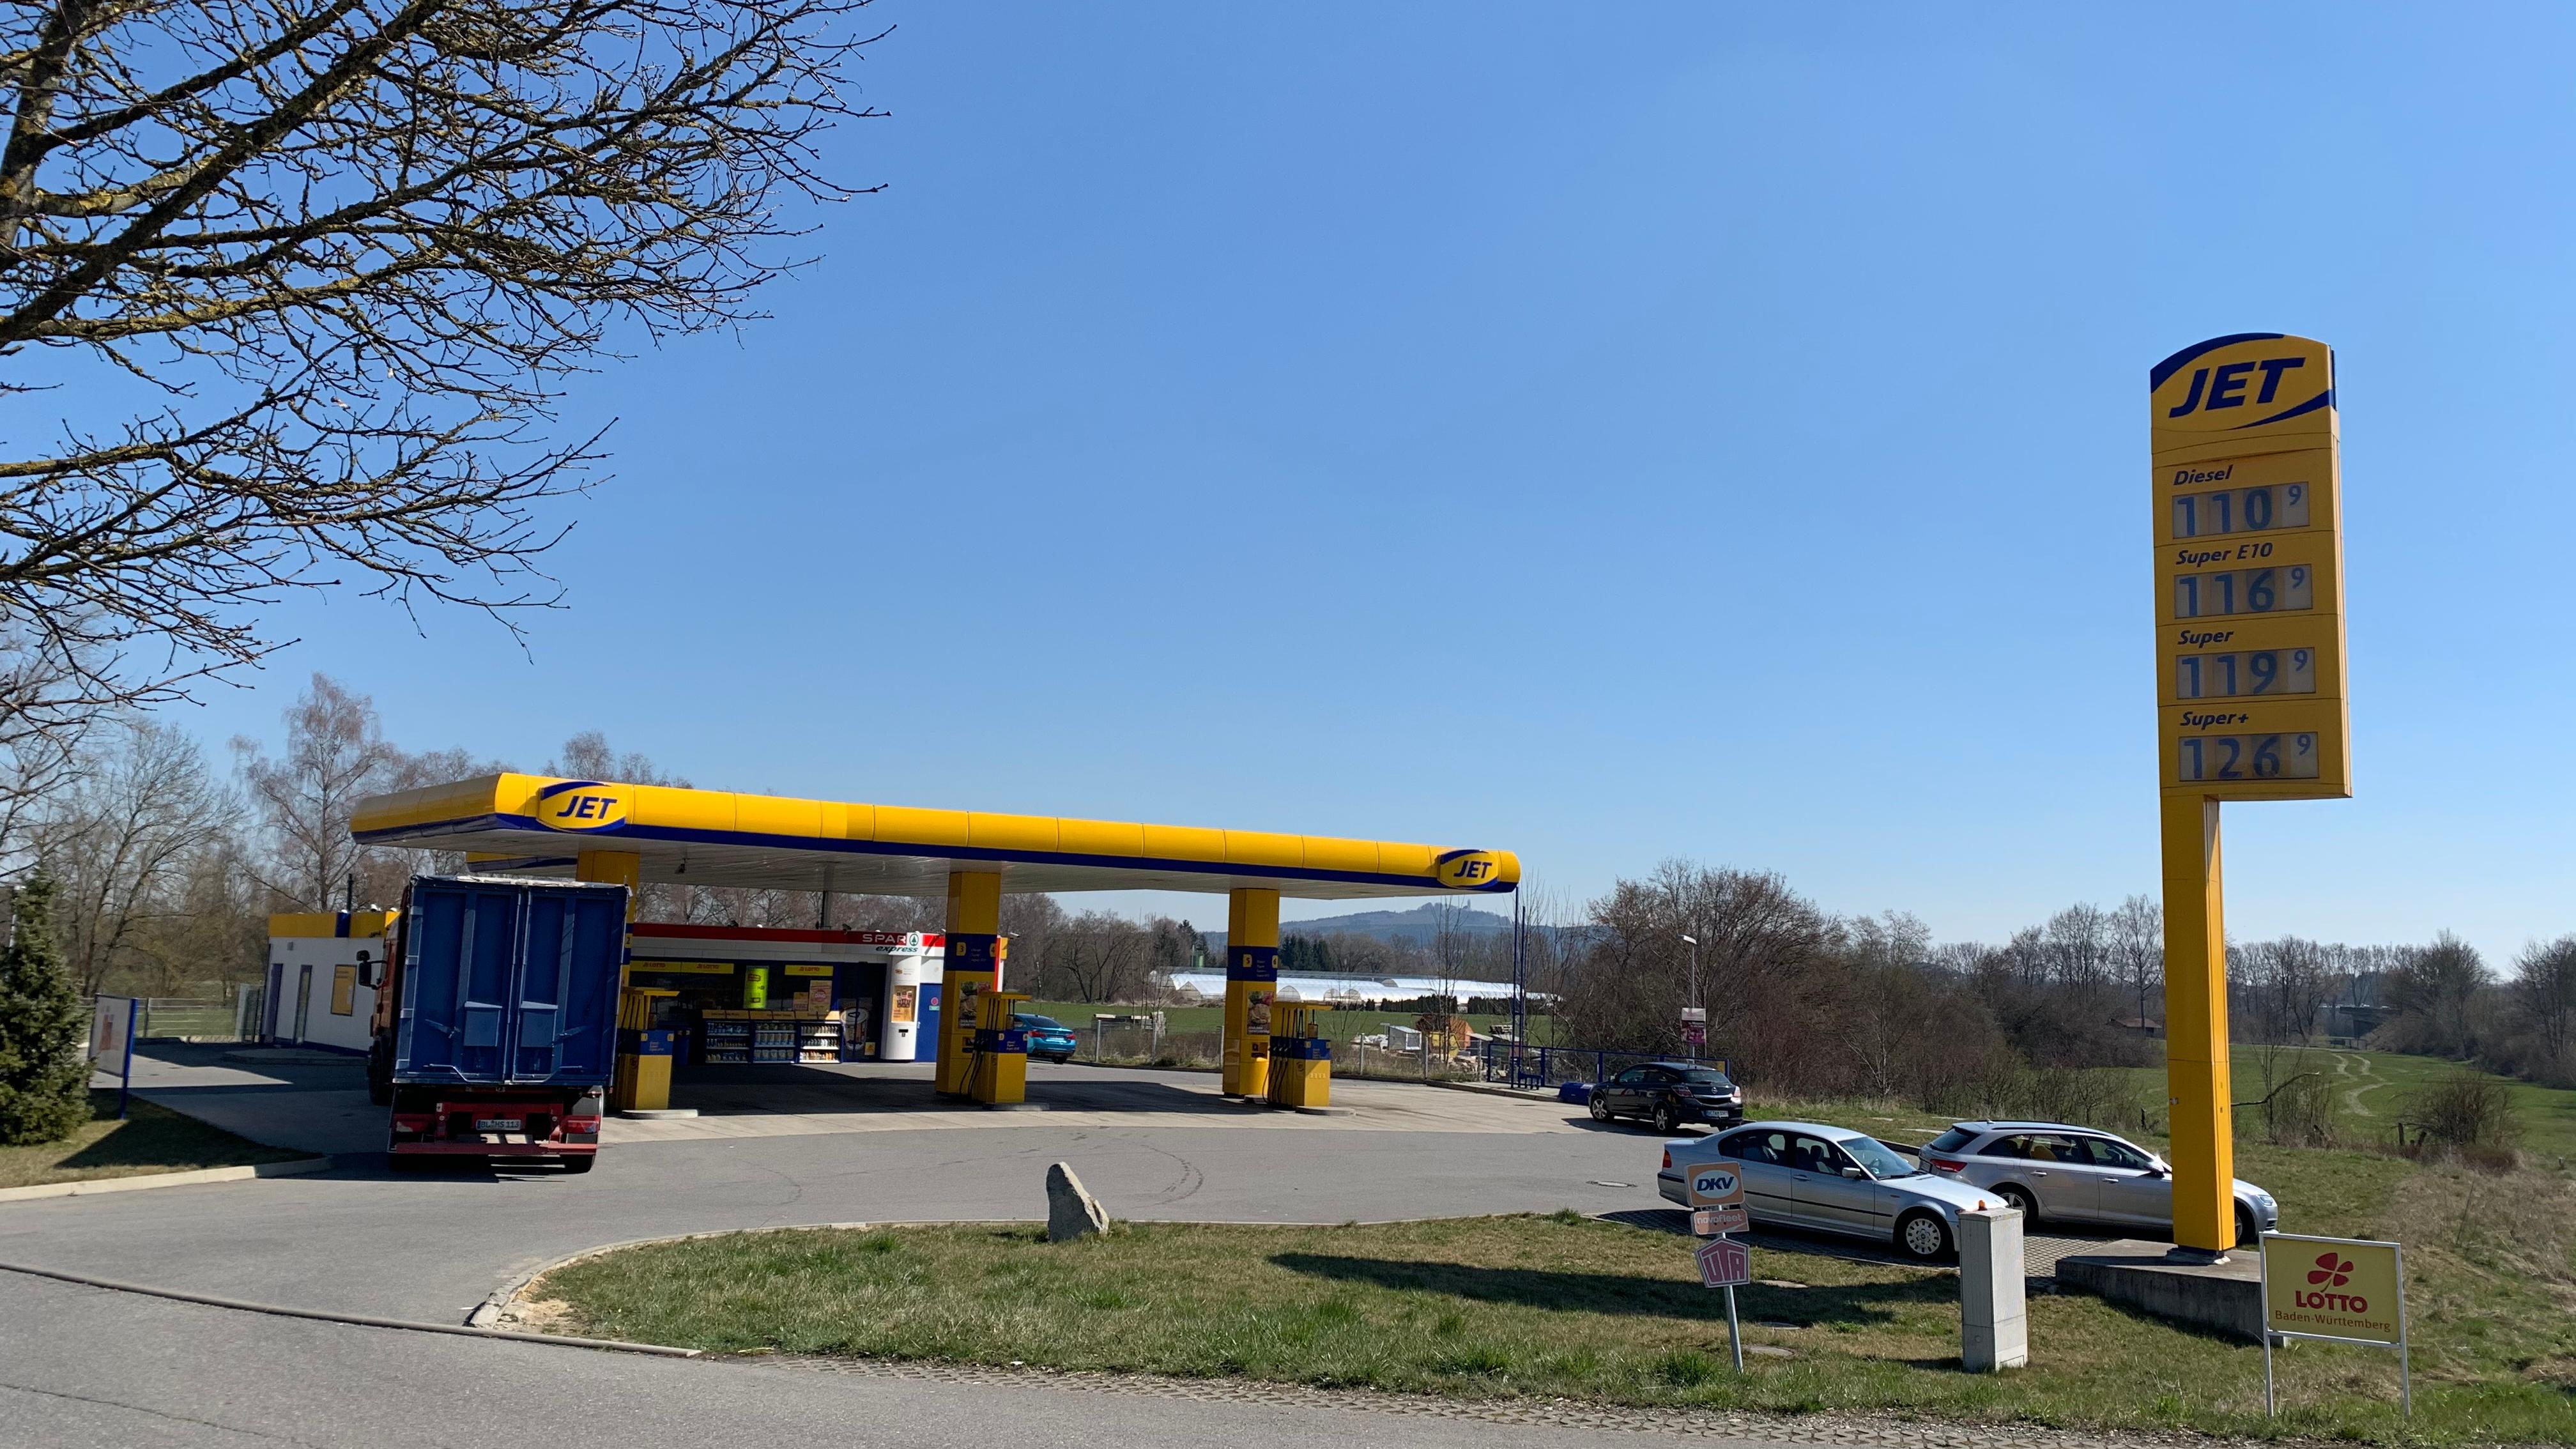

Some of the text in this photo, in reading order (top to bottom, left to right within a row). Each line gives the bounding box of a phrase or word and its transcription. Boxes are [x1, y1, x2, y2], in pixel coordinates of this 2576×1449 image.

[2168, 356, 2306, 418] JET
[2174, 464, 2234, 486] Diesel
[2175, 542, 2273, 568] Super E10
[2177, 629, 2234, 648] Super
[2179, 710, 2250, 730] Super+
[556, 795, 618, 819] JET
[1453, 860, 1492, 879] JET
[862, 933, 907, 944] SPAR
[875, 946, 918, 954] express
[1696, 1176, 1735, 1192] DKV
[1696, 1213, 1743, 1225] novofleet
[2295, 1290, 2368, 1314] LOTTO
[2274, 1310, 2391, 1333] Baden-Württemberg
